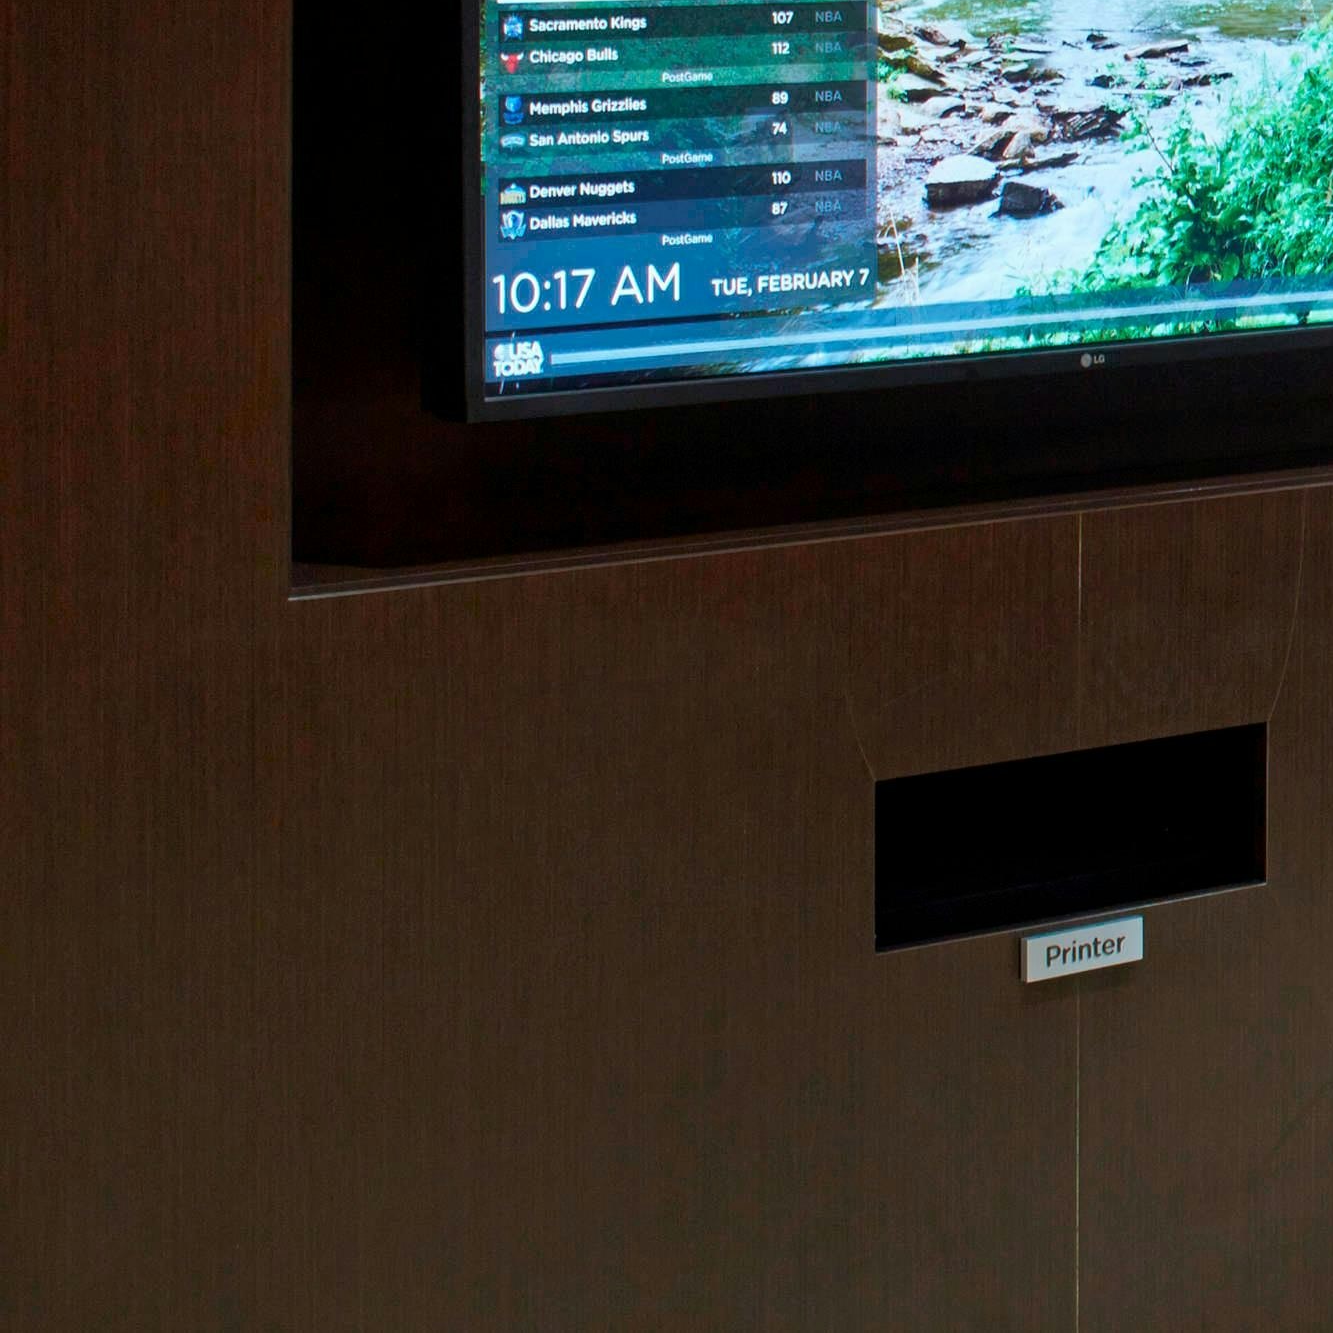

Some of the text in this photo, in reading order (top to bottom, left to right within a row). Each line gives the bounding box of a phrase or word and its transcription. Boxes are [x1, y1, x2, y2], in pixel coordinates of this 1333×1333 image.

[529, 10, 843, 33] Sacramento Kings 107 NBA
[529, 41, 842, 65] Chicago Bulls 112 NBA
[662, 71, 714, 83] PostGame
[529, 90, 843, 116] Memphis Grizzlies 89 NBA
[529, 121, 842, 148] San Antonio Spurs 74 NBA
[662, 152, 714, 165] PostGame
[529, 169, 843, 199] Denver Nuggets 110 NBA
[529, 200, 842, 231] Dallas Mavericks 87 NBA
[662, 233, 714, 246] PostGame
[491, 261, 682, 315] 10:17 AM
[711, 268, 871, 298] TUE, FEBRUARY 7
[1093, 353, 1105, 364] LG
[1046, 936, 1126, 968] Printer
